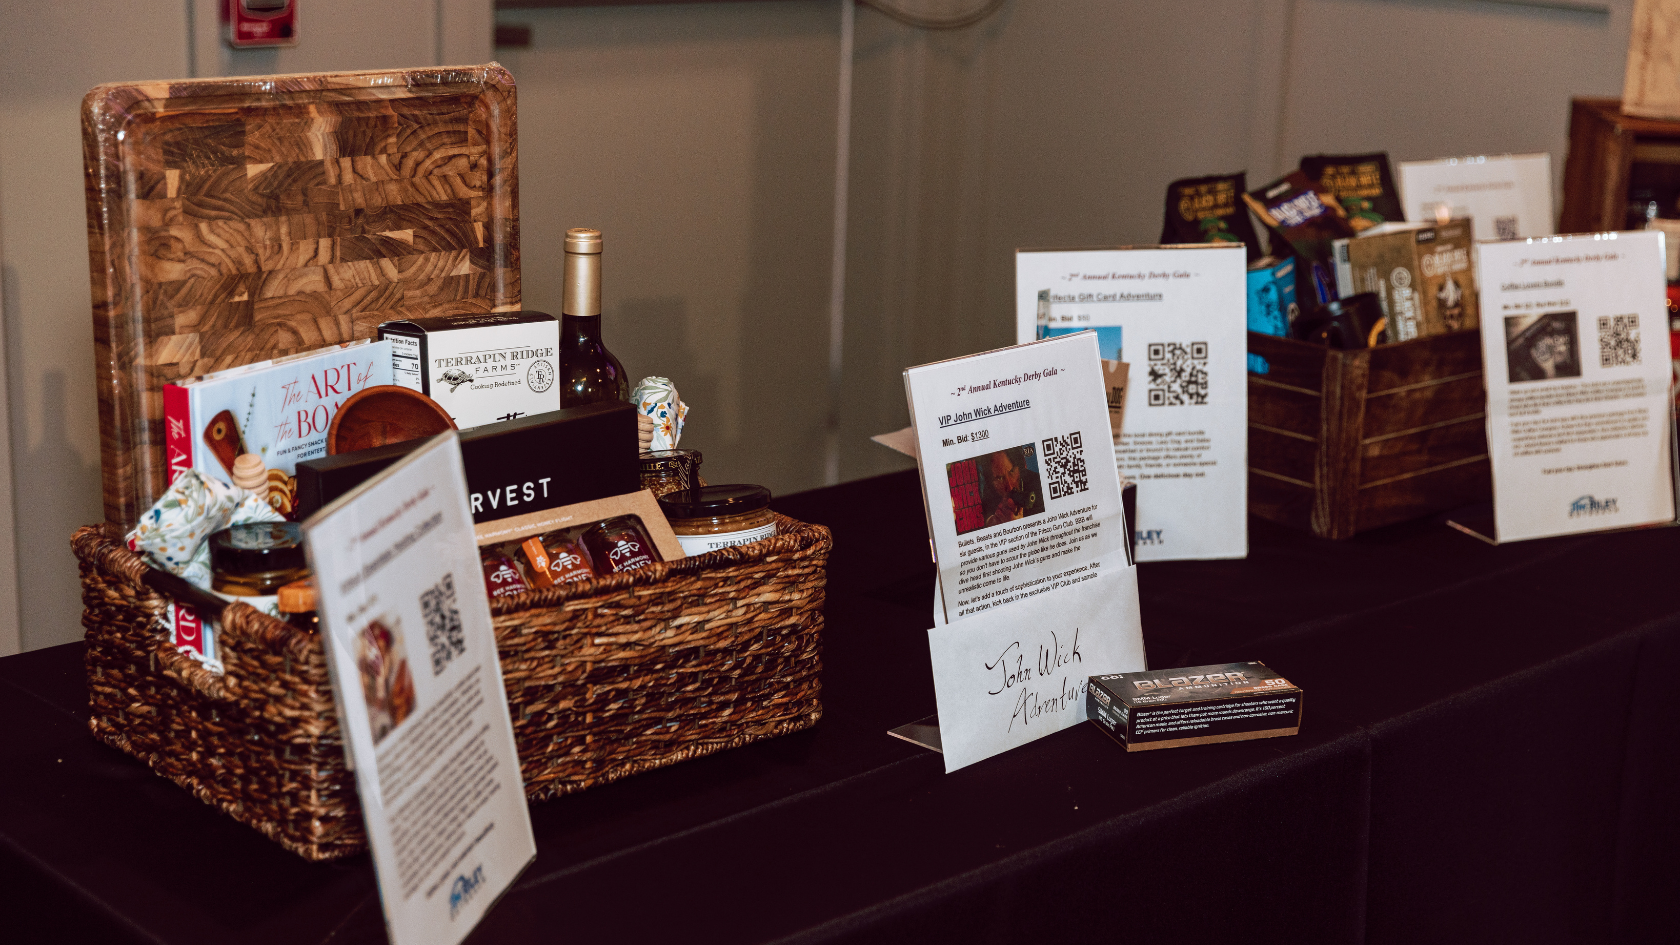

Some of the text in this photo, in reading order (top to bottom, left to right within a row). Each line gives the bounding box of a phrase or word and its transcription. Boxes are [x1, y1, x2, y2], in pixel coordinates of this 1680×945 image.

[1112, 272, 1146, 281] Kentucky
[1148, 271, 1170, 280] Derby
[1172, 271, 1191, 279] Gala
[1096, 292, 1118, 301] Card
[1120, 292, 1164, 301] Adventure
[411, 362, 419, 370] 70
[434, 348, 554, 368] TERRAPIN RIDGE
[281, 361, 374, 413] The ART of
[470, 378, 522, 391] Cooking Redefined
[968, 380, 992, 394] Annual
[992, 374, 1022, 389] Kentucky
[1023, 372, 1042, 383] Derby
[1042, 367, 1058, 378] Gala
[938, 398, 1030, 426] VIP John Wick Adventure
[274, 416, 295, 448] the
[942, 438, 956, 448] Min.
[957, 434, 970, 444] Bid:
[291, 444, 307, 452] FANCY
[308, 438, 324, 448] SNACK
[950, 459, 978, 488] JOHN
[951, 483, 982, 510] WICK
[514, 523, 537, 532] CLASSIC
[555, 514, 574, 523] FLIGHT
[954, 504, 985, 532] GUNS
[708, 536, 758, 550] TERRAPIN
[984, 628, 1082, 695] John Wick
[1132, 672, 1246, 691] BLAZER
[1178, 680, 1250, 691] AMMUNITION
[1264, 678, 1286, 686] 50
